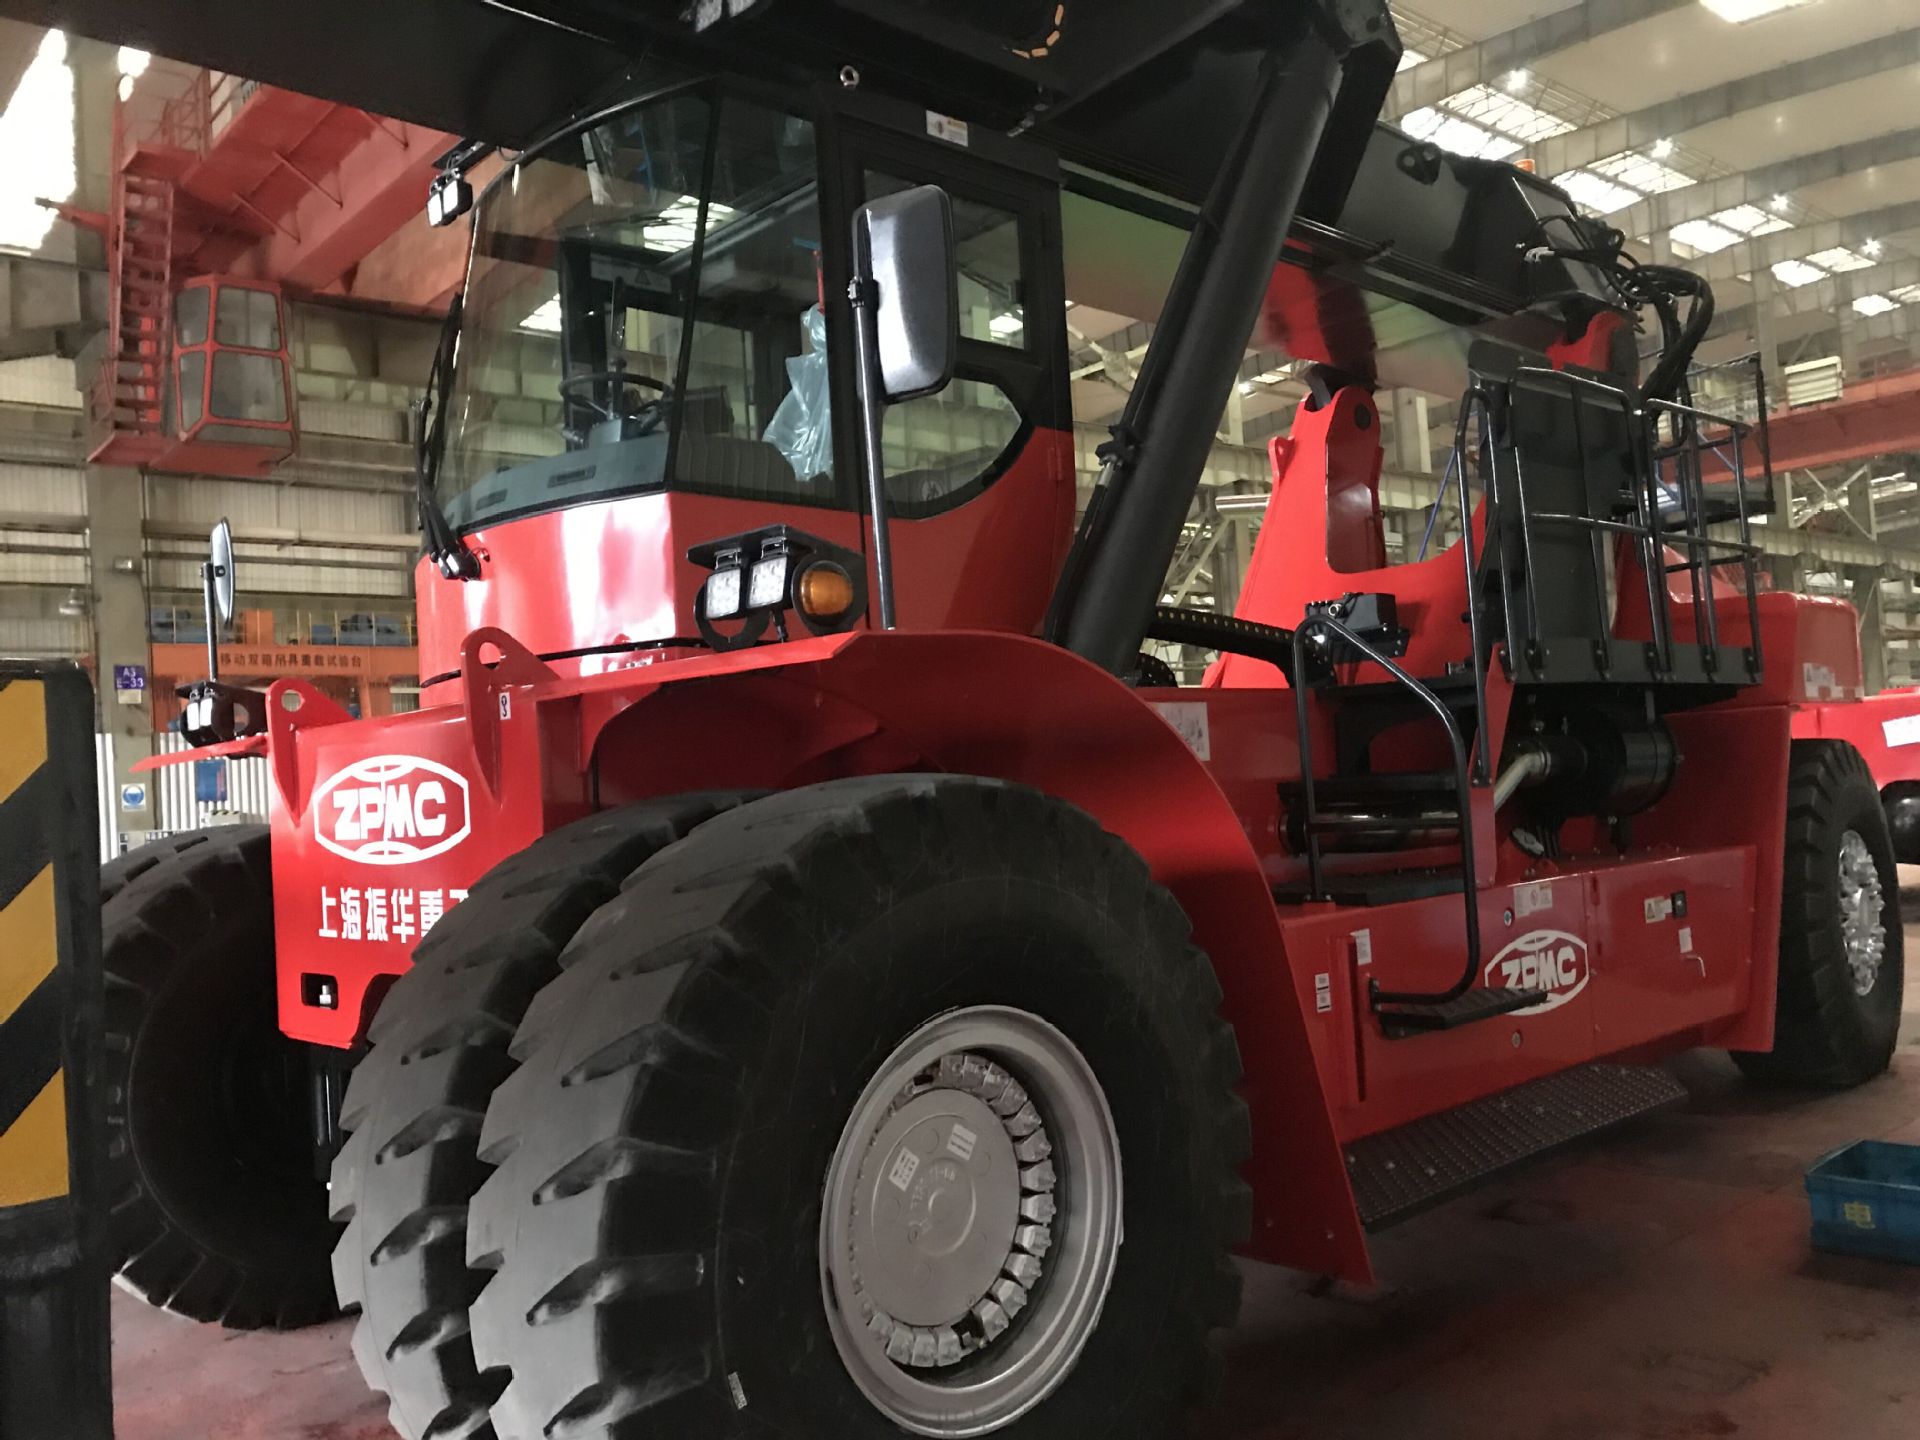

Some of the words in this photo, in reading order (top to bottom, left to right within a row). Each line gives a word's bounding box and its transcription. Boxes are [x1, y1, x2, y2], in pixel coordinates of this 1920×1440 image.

[116, 677, 144, 688] E-33
[123, 667, 136, 677] A3
[333, 781, 446, 840] ZPMC
[1501, 946, 1577, 991] ZPMC
